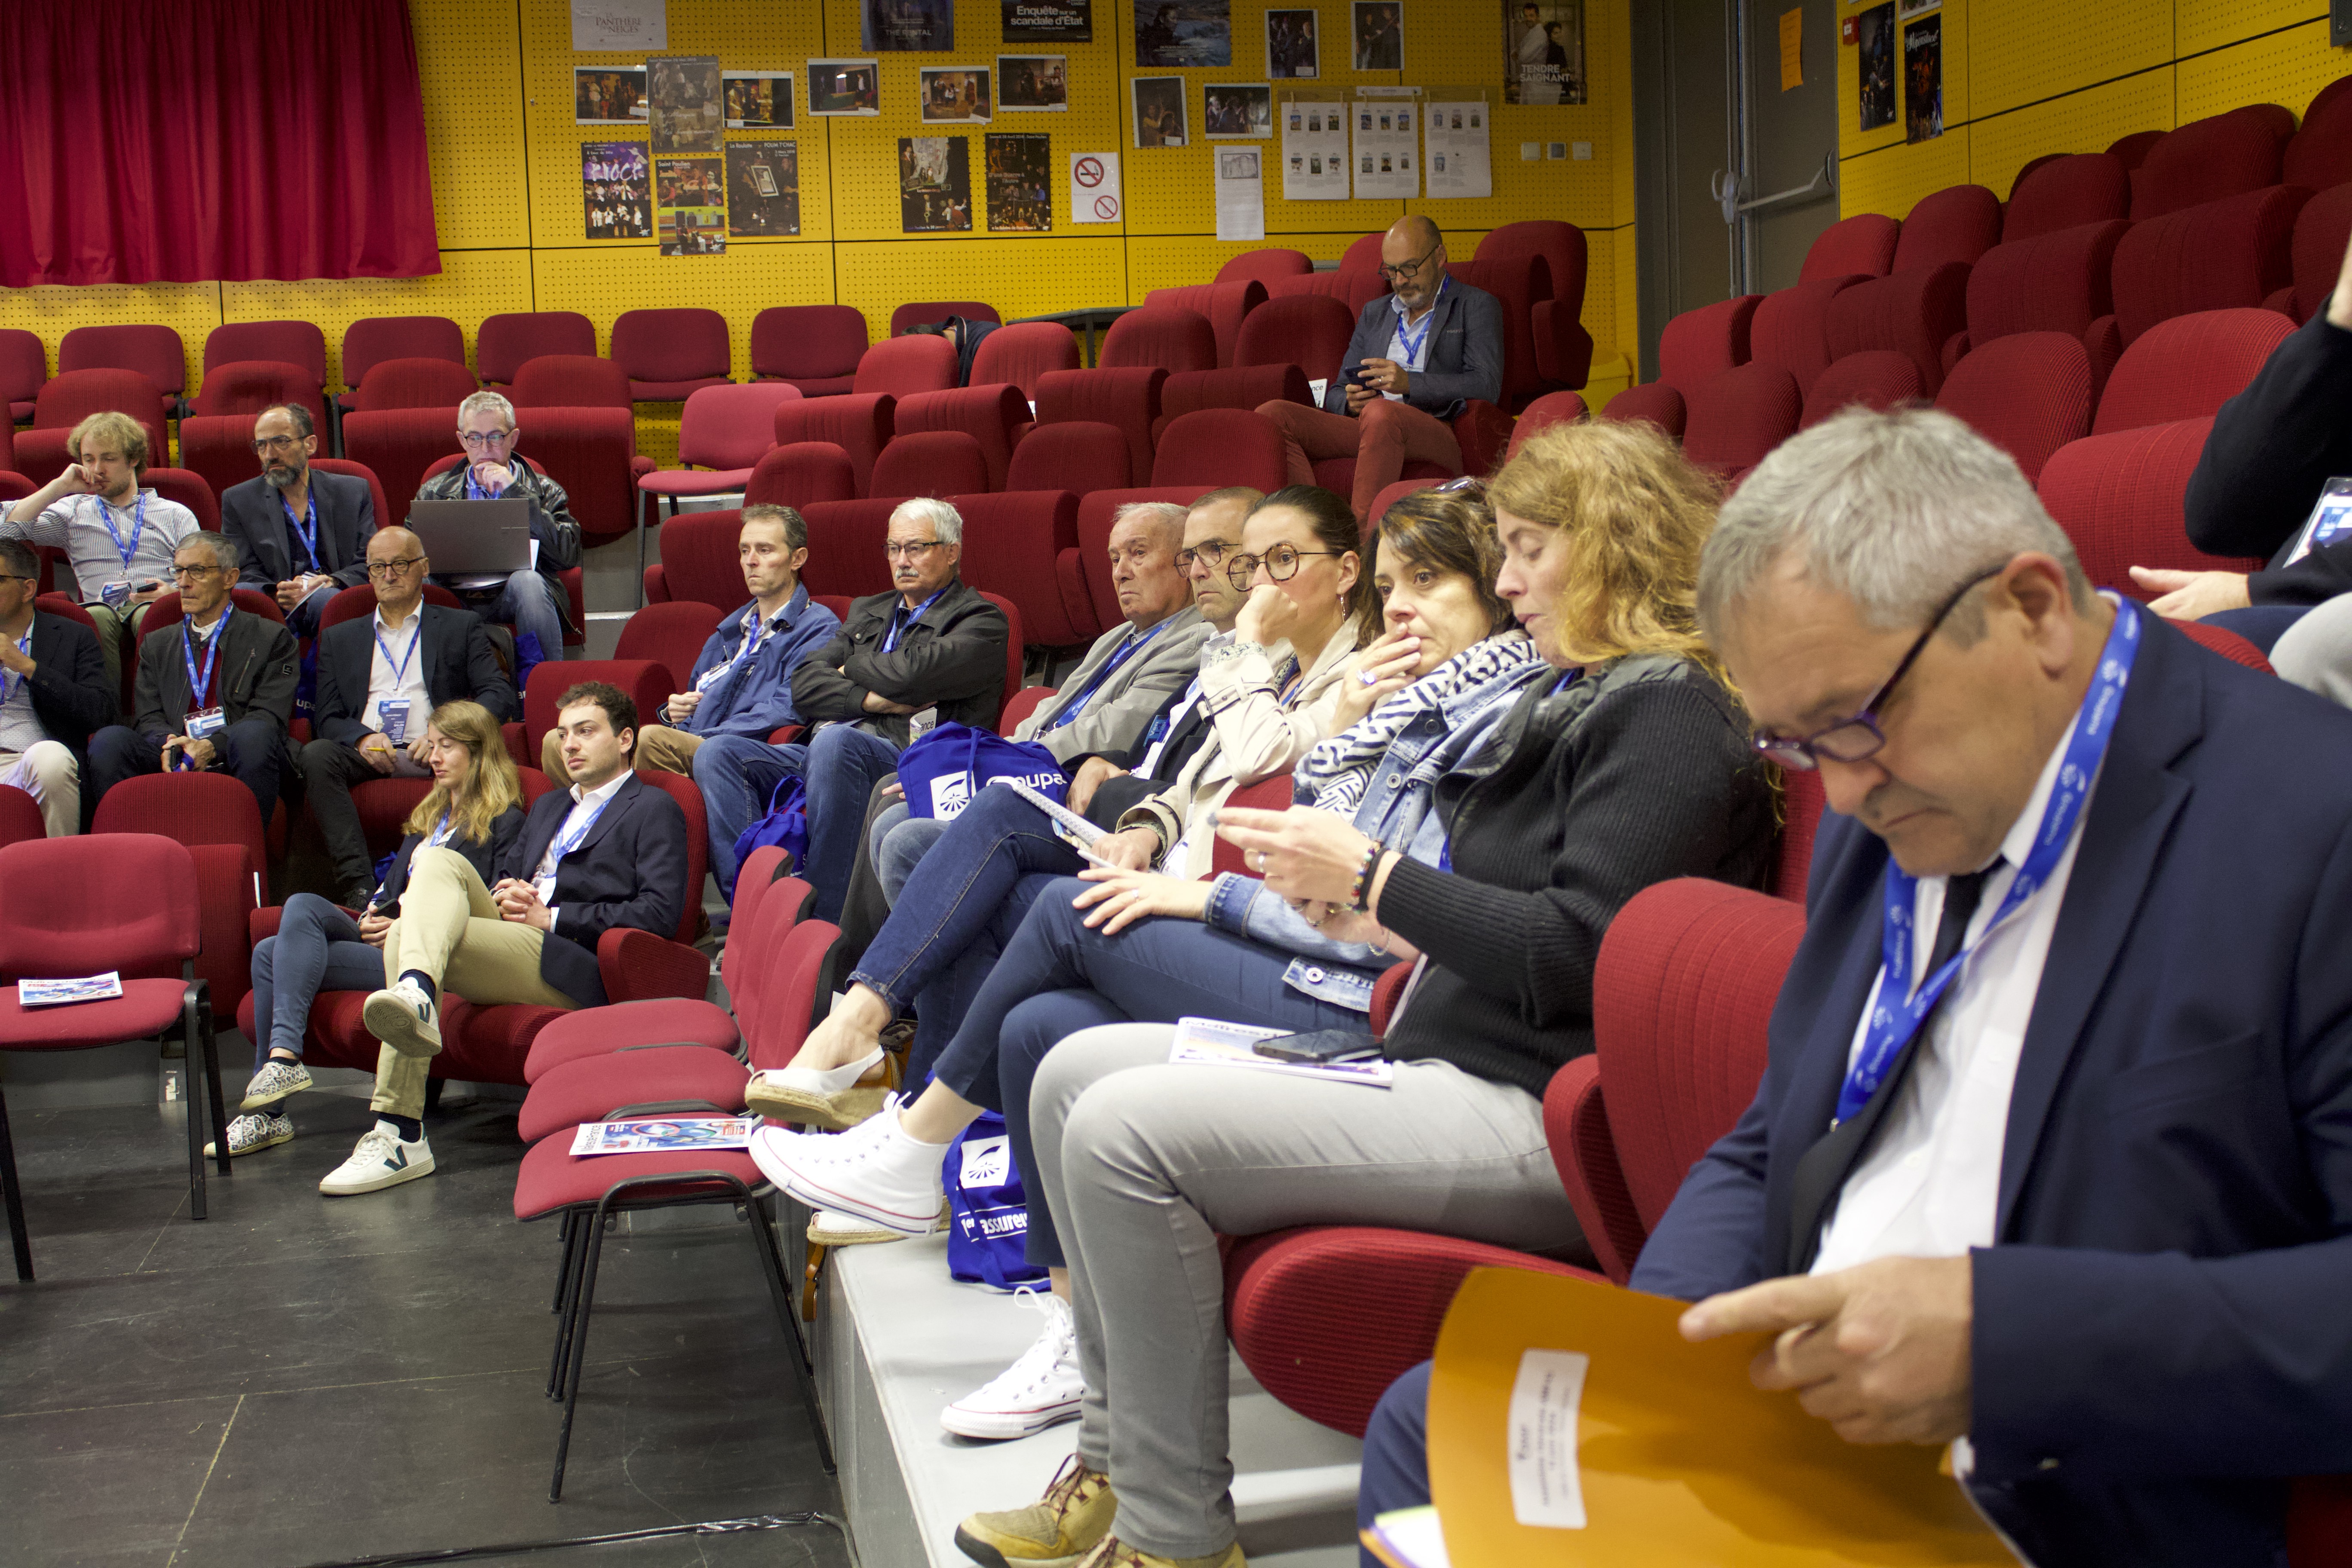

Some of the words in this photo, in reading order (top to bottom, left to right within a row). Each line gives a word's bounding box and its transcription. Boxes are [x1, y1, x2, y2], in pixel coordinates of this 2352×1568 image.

[1017, 5, 1059, 17] Enquête
[1011, 16, 1054, 26] scandale
[1522, 64, 1560, 73] TENDRE
[1520, 74, 1570, 83] SAIGNANT
[980, 1213, 1027, 1235] assureu
